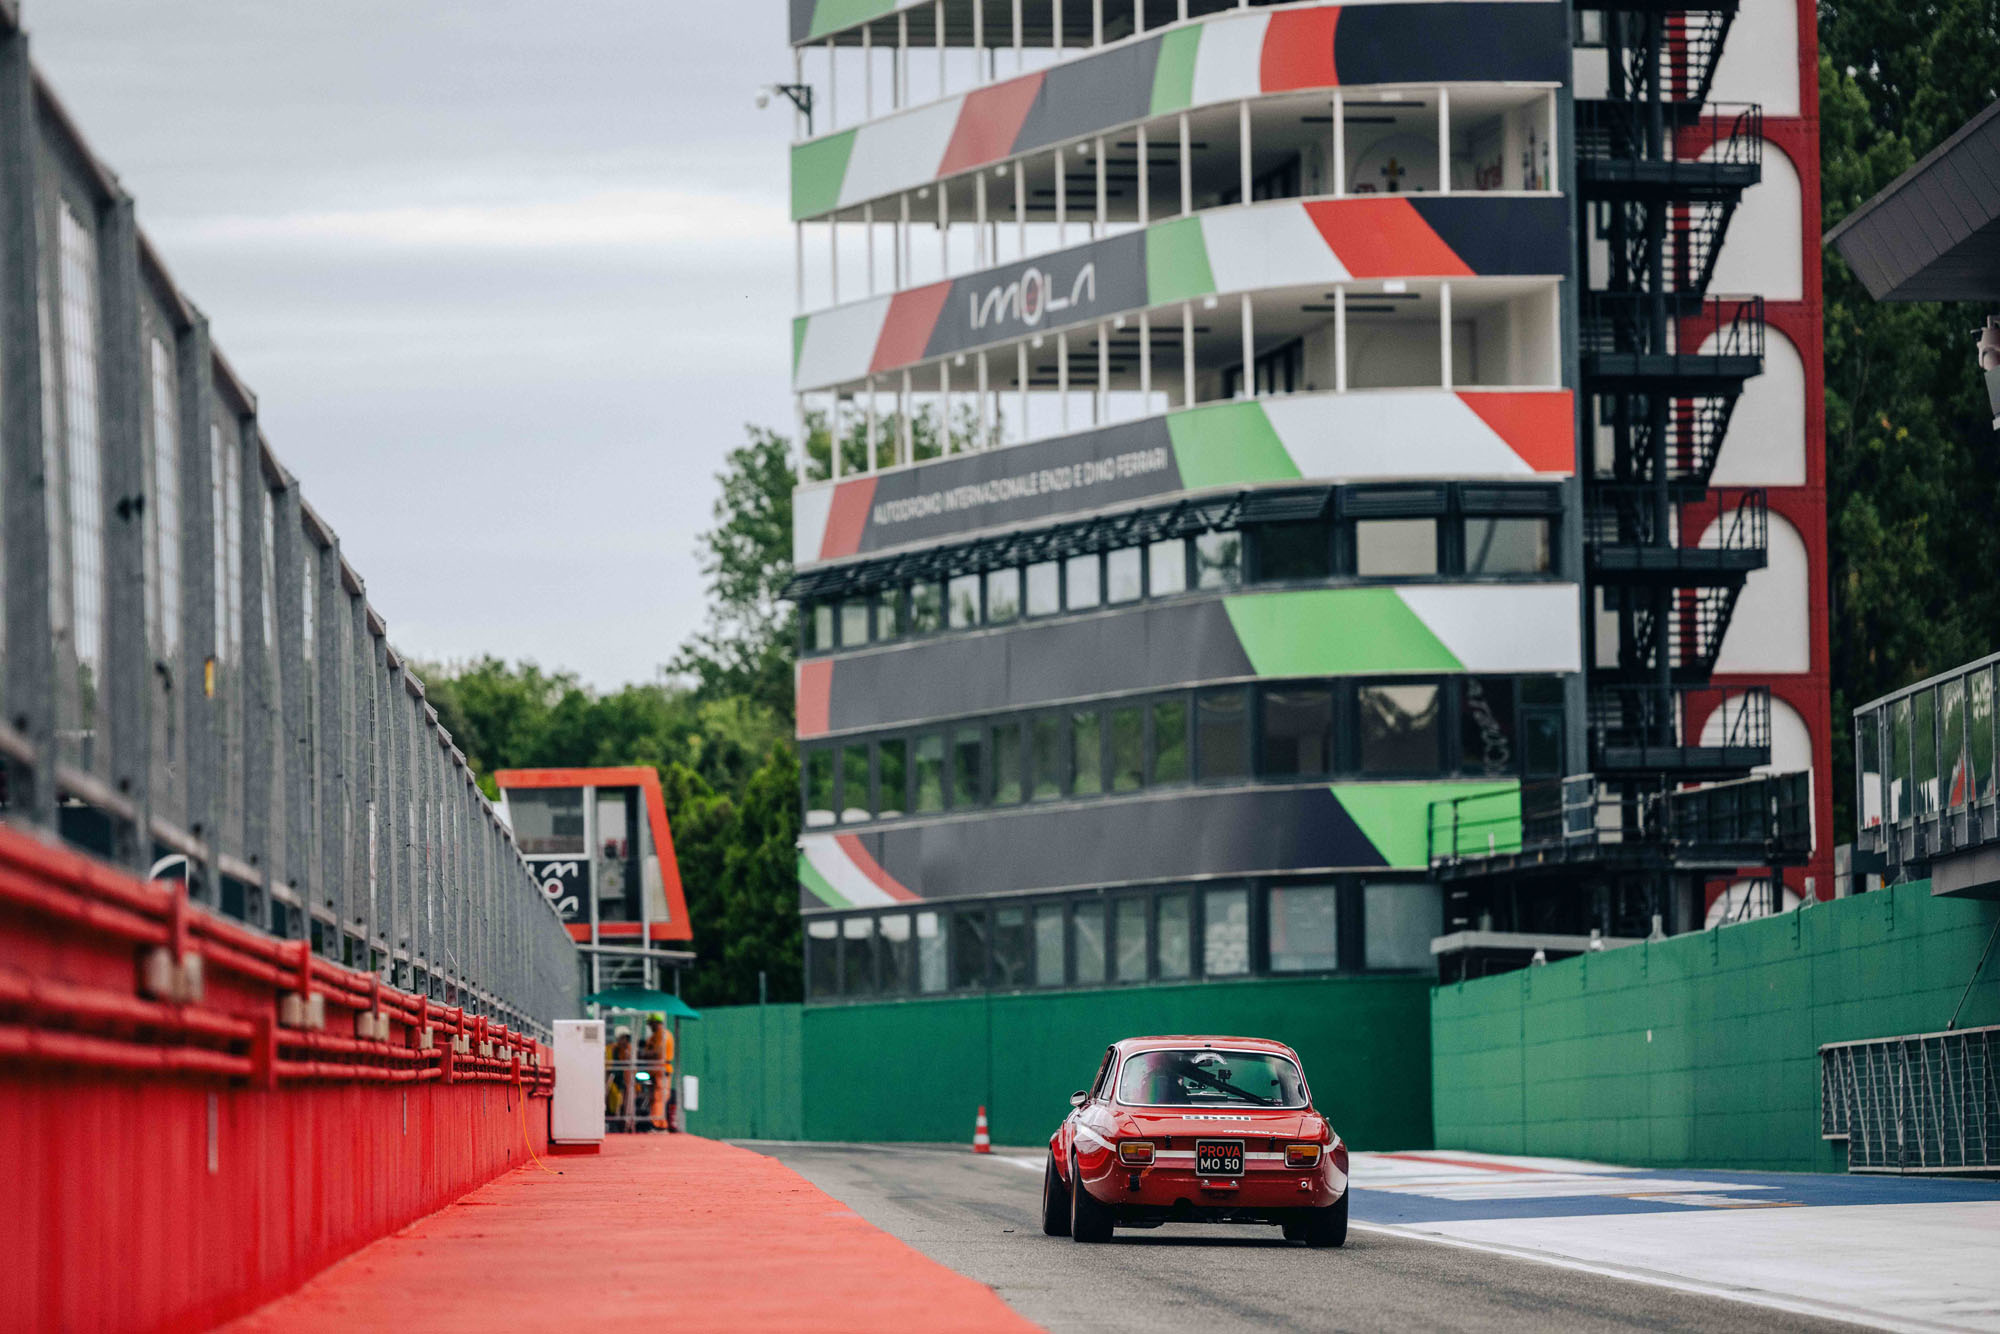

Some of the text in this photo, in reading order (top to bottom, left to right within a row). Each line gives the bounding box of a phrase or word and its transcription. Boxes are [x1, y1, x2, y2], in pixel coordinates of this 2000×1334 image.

[970, 262, 1095, 330] IMOLA
[1072, 463, 1083, 488] E
[1199, 1145, 1241, 1158] PROVA
[1200, 1158, 1240, 1170] MO 50
